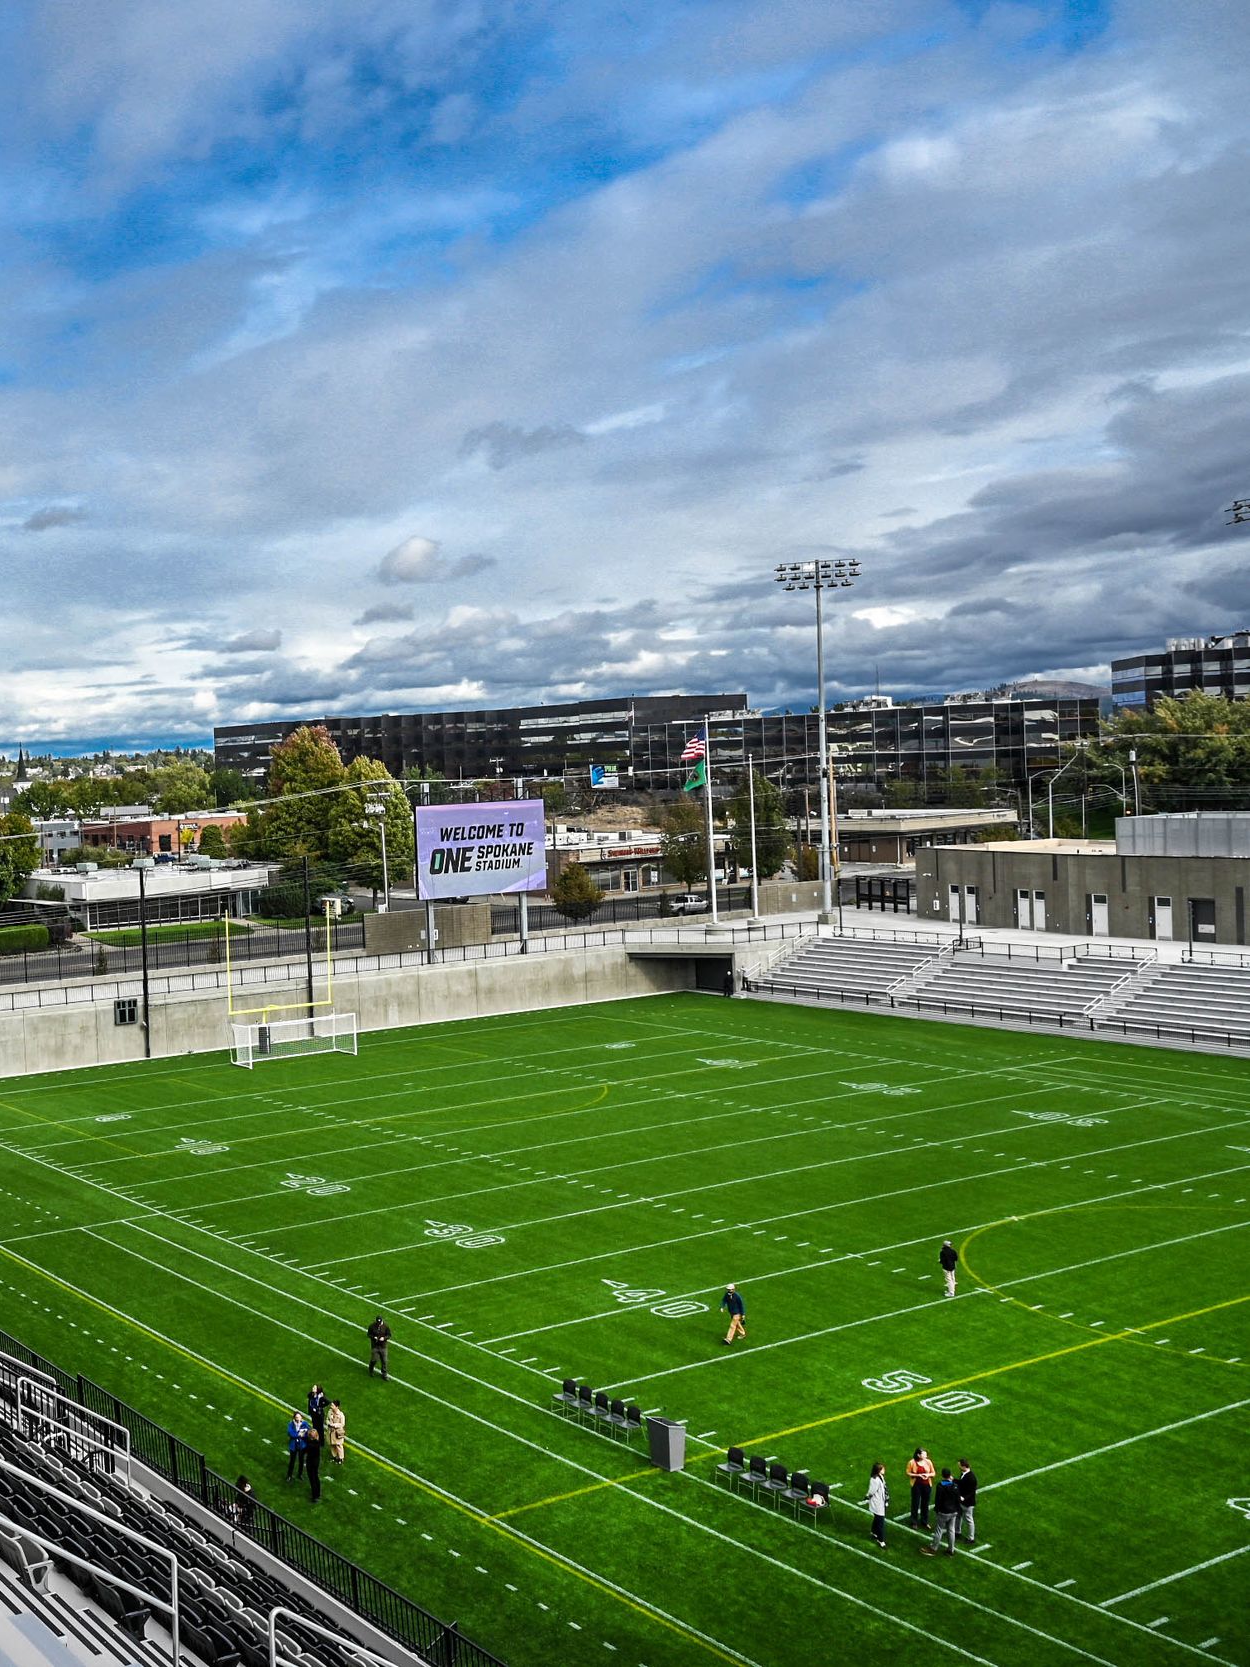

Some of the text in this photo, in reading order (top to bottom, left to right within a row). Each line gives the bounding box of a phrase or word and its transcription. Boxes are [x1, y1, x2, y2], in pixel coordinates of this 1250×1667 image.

[440, 822, 525, 842] WELCOME TO
[429, 842, 534, 875] ONE SPOKANE
[475, 858, 521, 872] STADIUM
[280, 1176, 350, 1196] 20
[424, 1224, 506, 1249] 30
[612, 1289, 710, 1318] 40
[861, 1369, 991, 1414] 50
